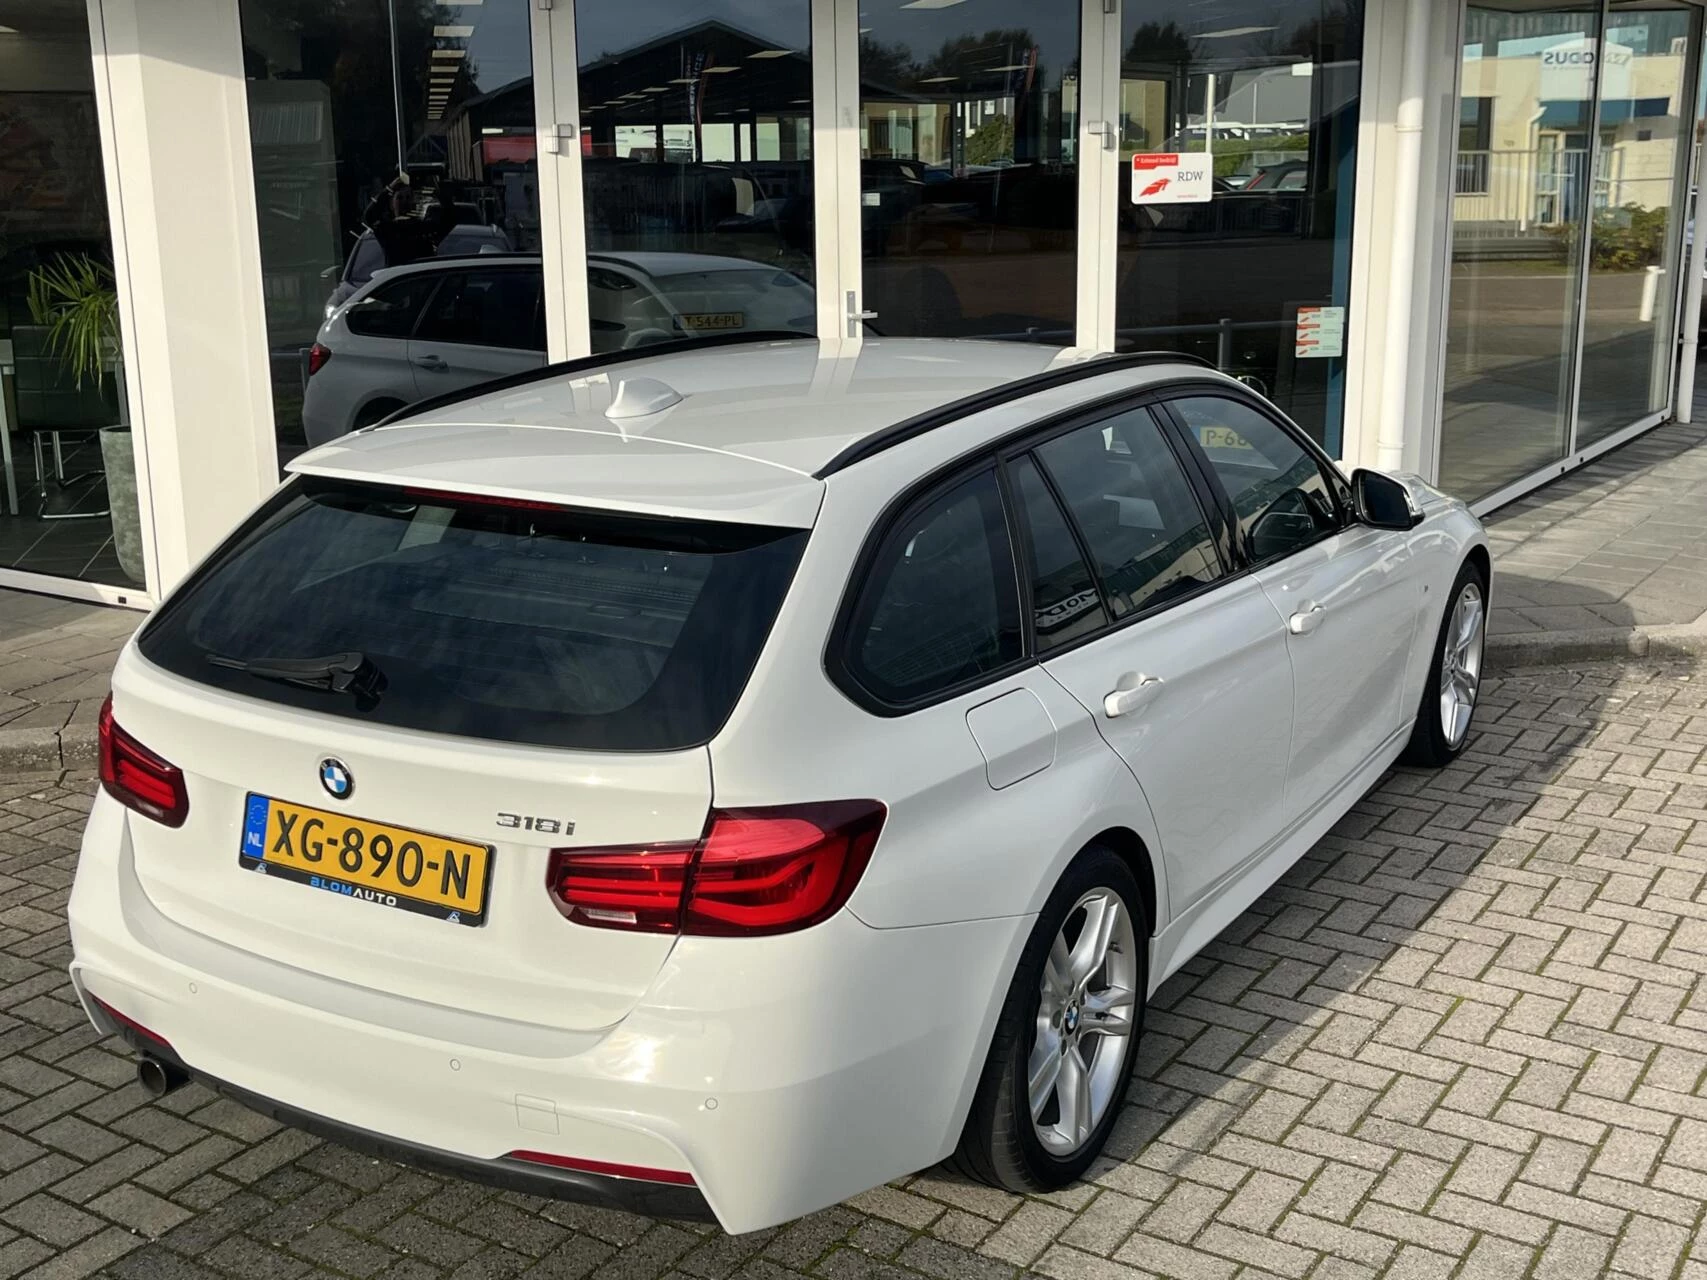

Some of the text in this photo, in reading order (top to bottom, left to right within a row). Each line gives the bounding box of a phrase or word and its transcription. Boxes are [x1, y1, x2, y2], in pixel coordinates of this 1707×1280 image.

[1177, 171, 1204, 182] RDW
[496, 812, 576, 836] 318i
[247, 831, 263, 848] NL
[271, 809, 471, 900] XG-890-N
